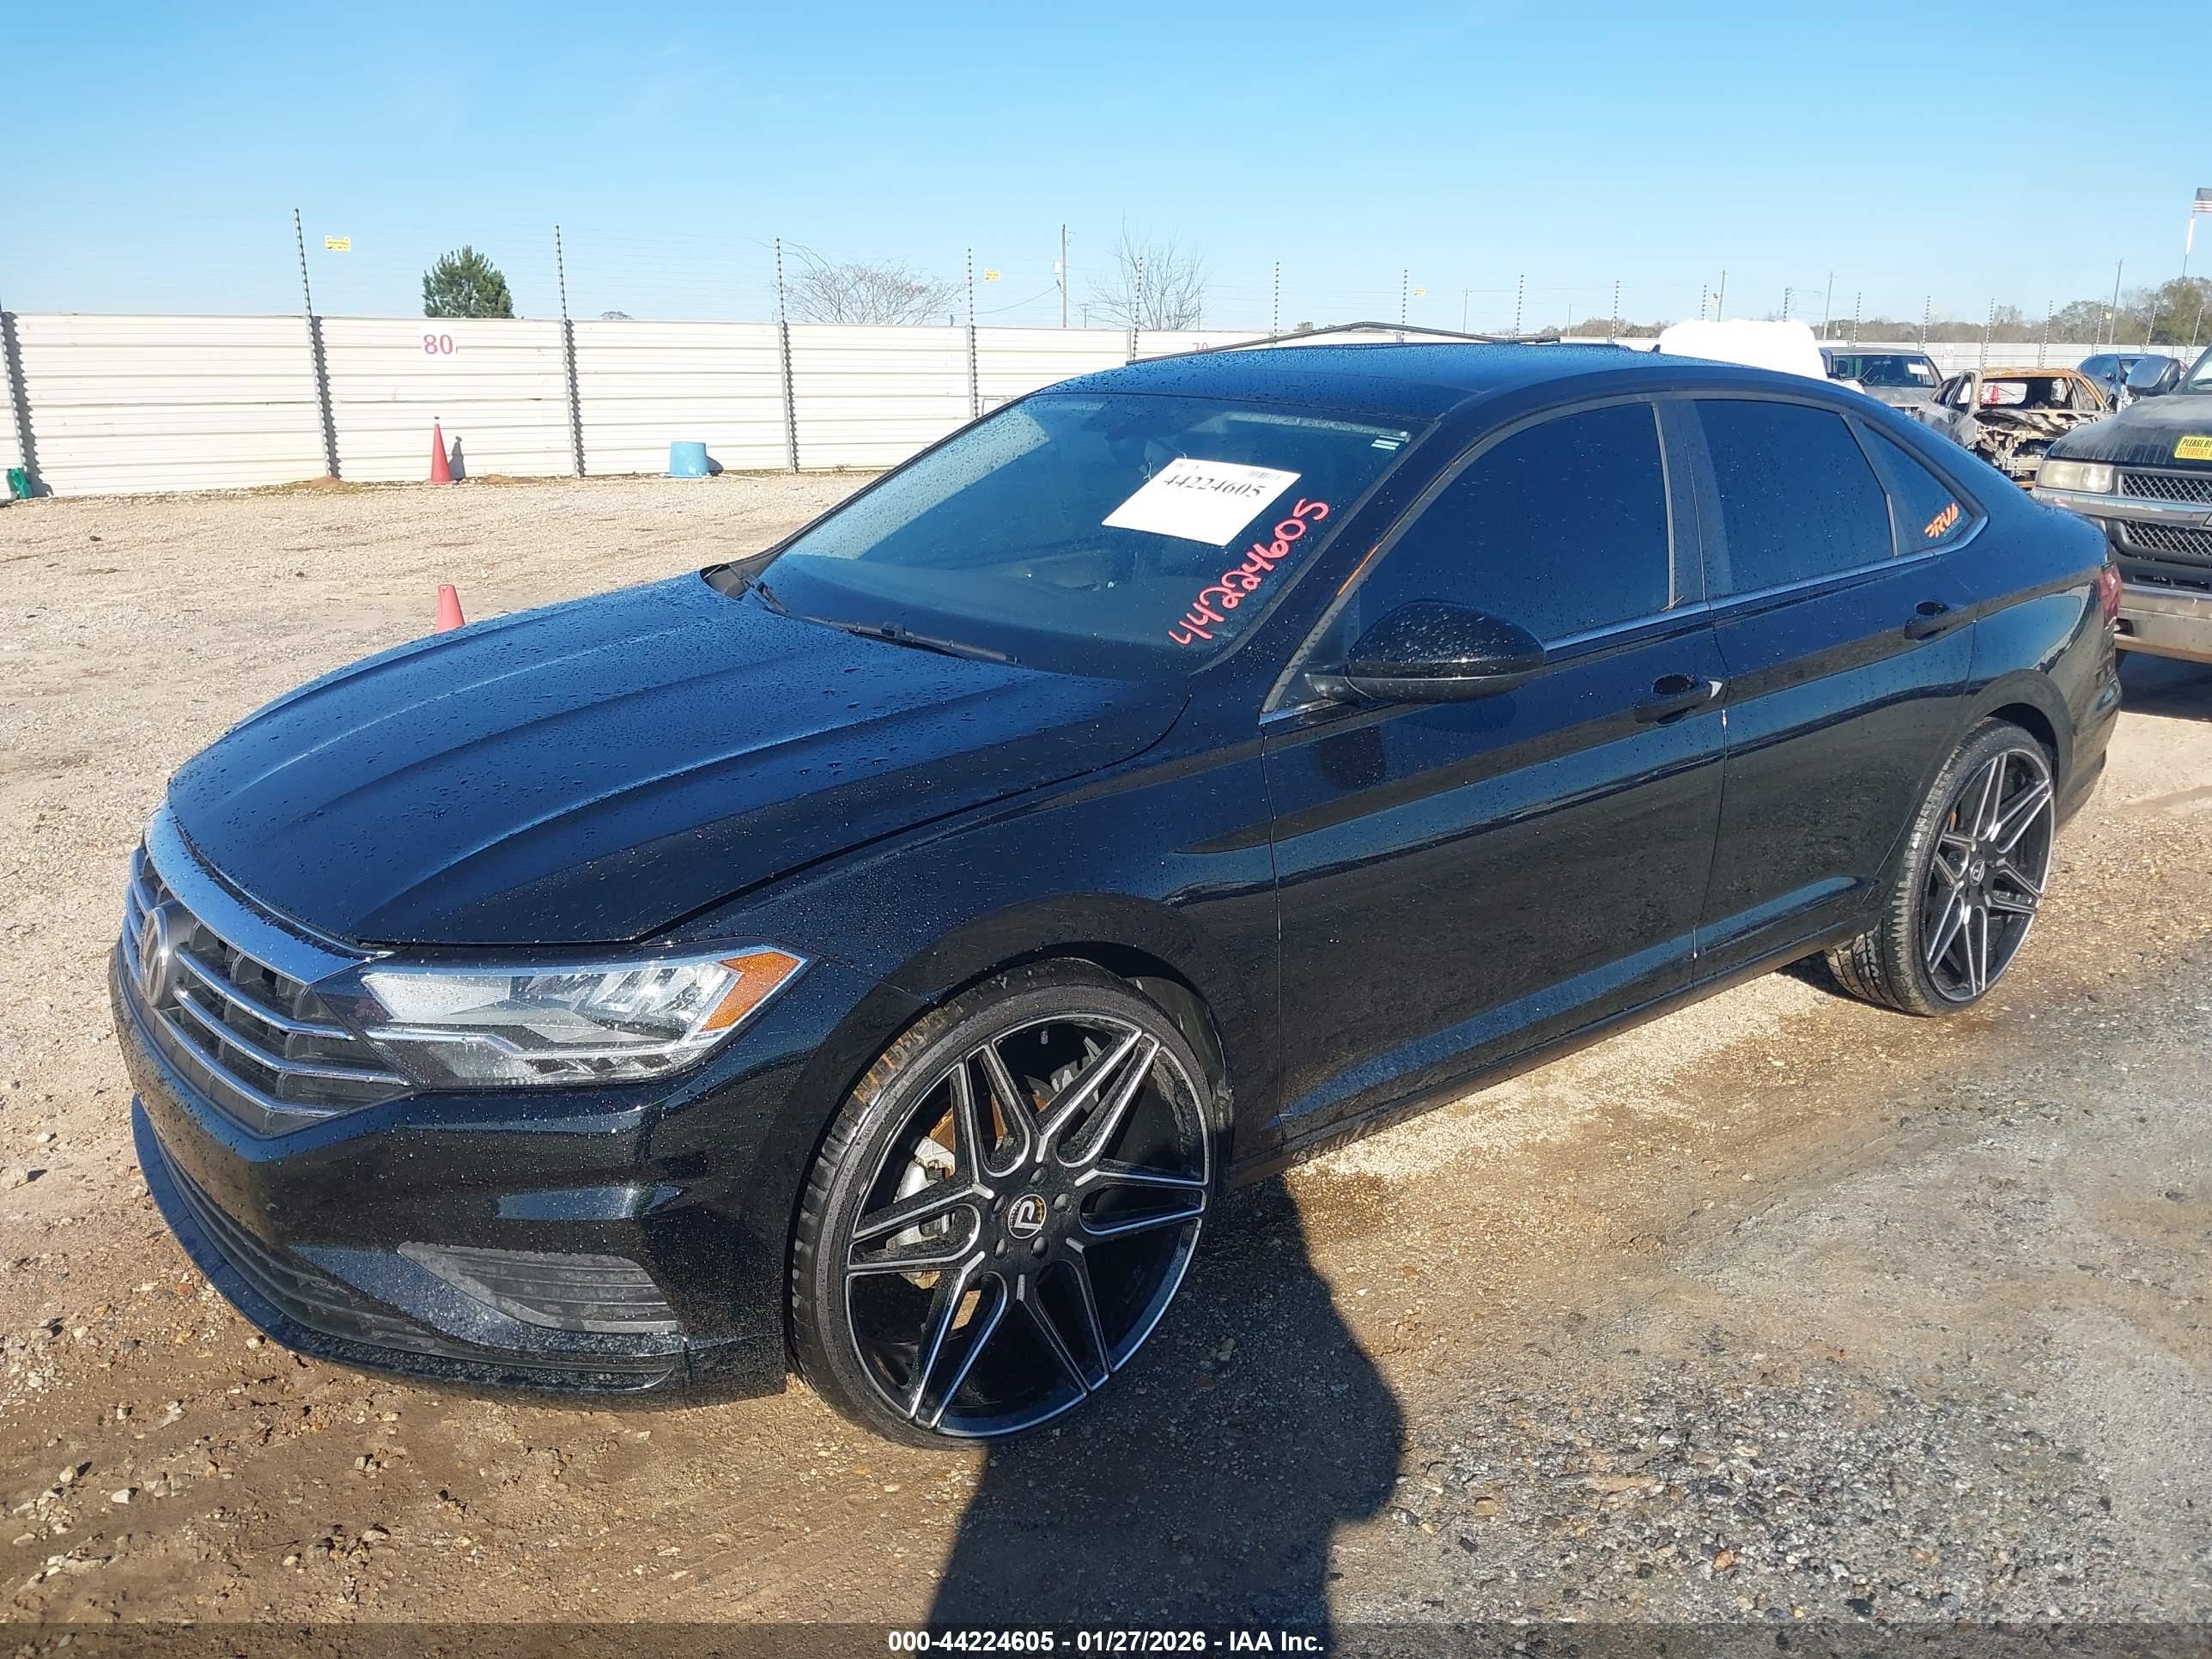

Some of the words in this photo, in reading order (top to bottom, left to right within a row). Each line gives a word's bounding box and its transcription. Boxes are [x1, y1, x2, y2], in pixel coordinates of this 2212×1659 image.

[423, 334, 453, 355] 80
[2182, 439, 2203, 447] PLEASE
[1164, 474, 1267, 498] 44224605
[1168, 497, 1330, 645] 44224605
